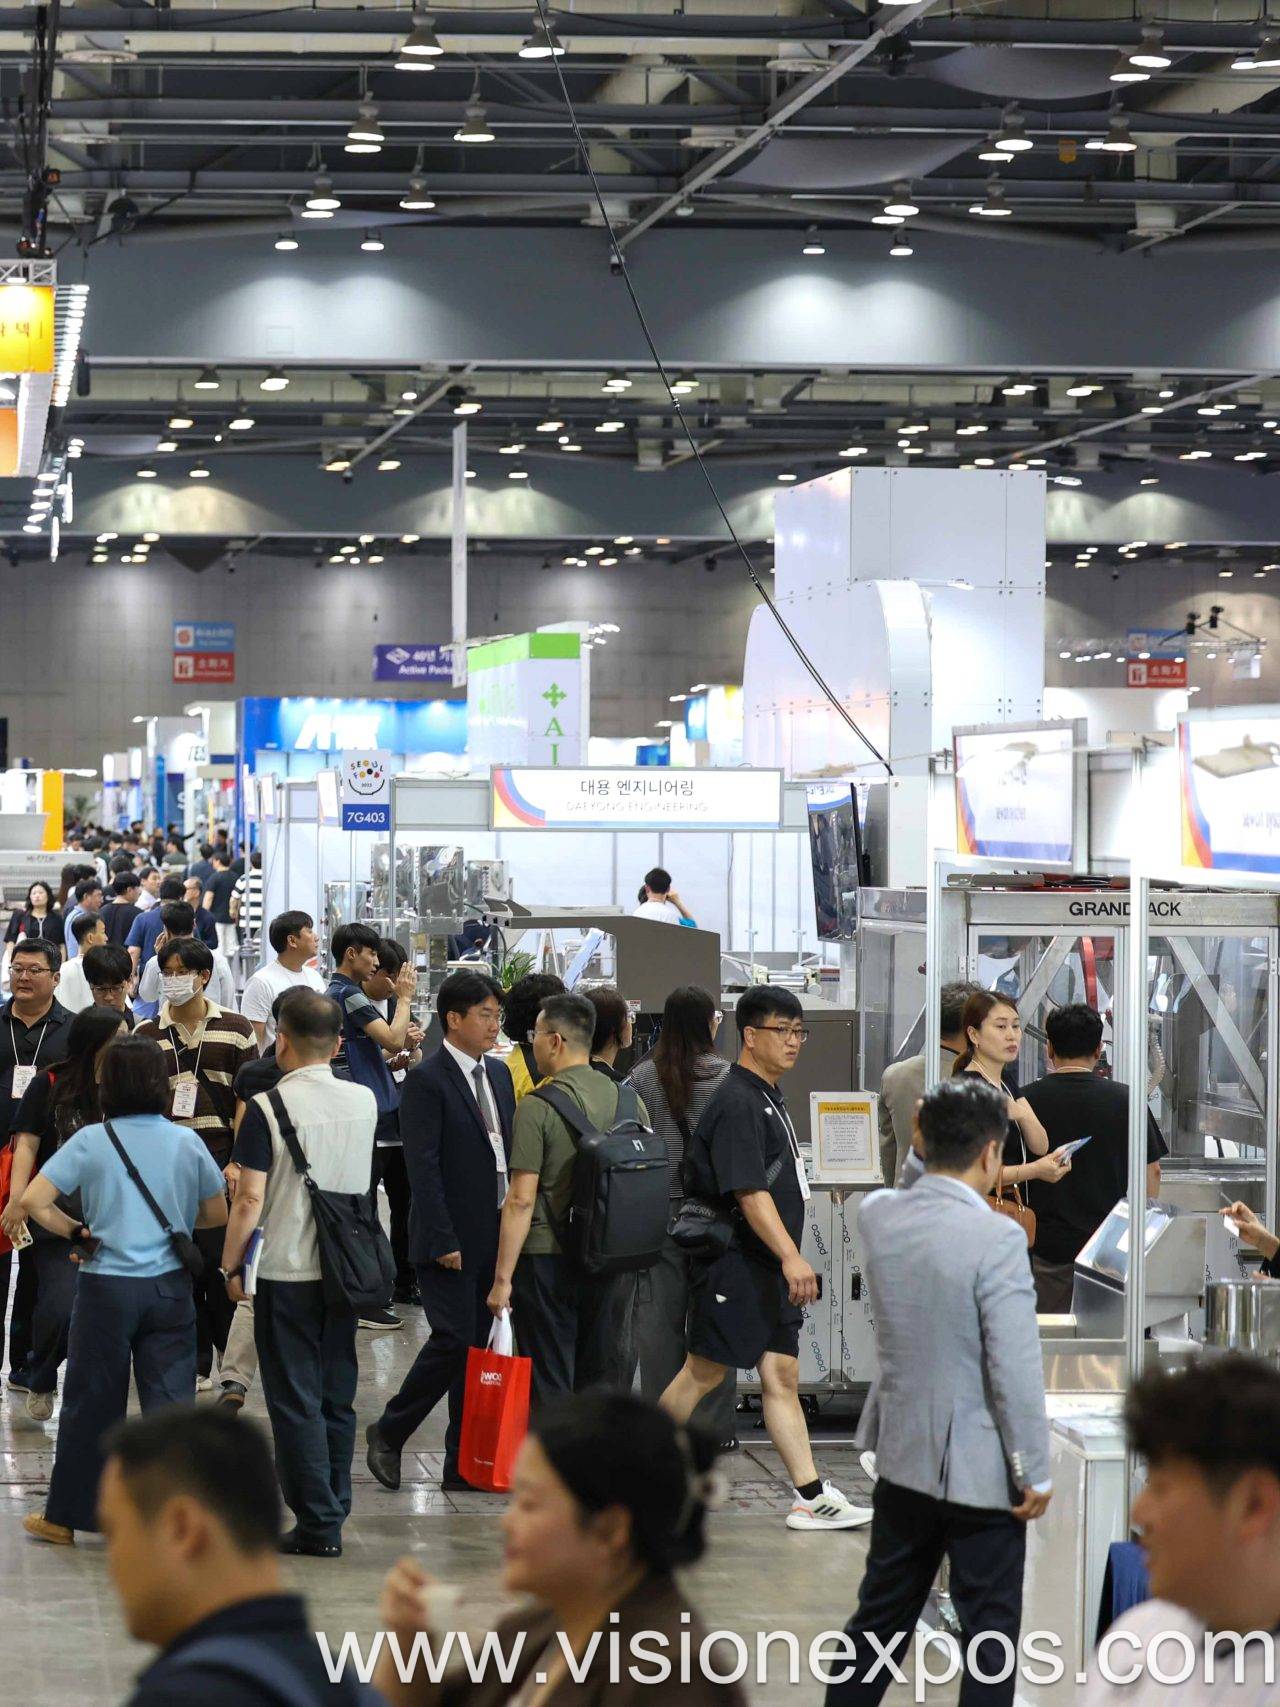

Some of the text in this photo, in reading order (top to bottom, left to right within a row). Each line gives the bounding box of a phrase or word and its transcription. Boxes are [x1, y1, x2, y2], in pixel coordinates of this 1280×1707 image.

[350, 760, 384, 772] SEOUL
[580, 779, 694, 796] 대용 엔지니어링
[347, 812, 386, 823] 7G403
[1069, 901, 1182, 917] GRANDACK
[811, 1224, 828, 1255] posco
[811, 1341, 827, 1373] posco
